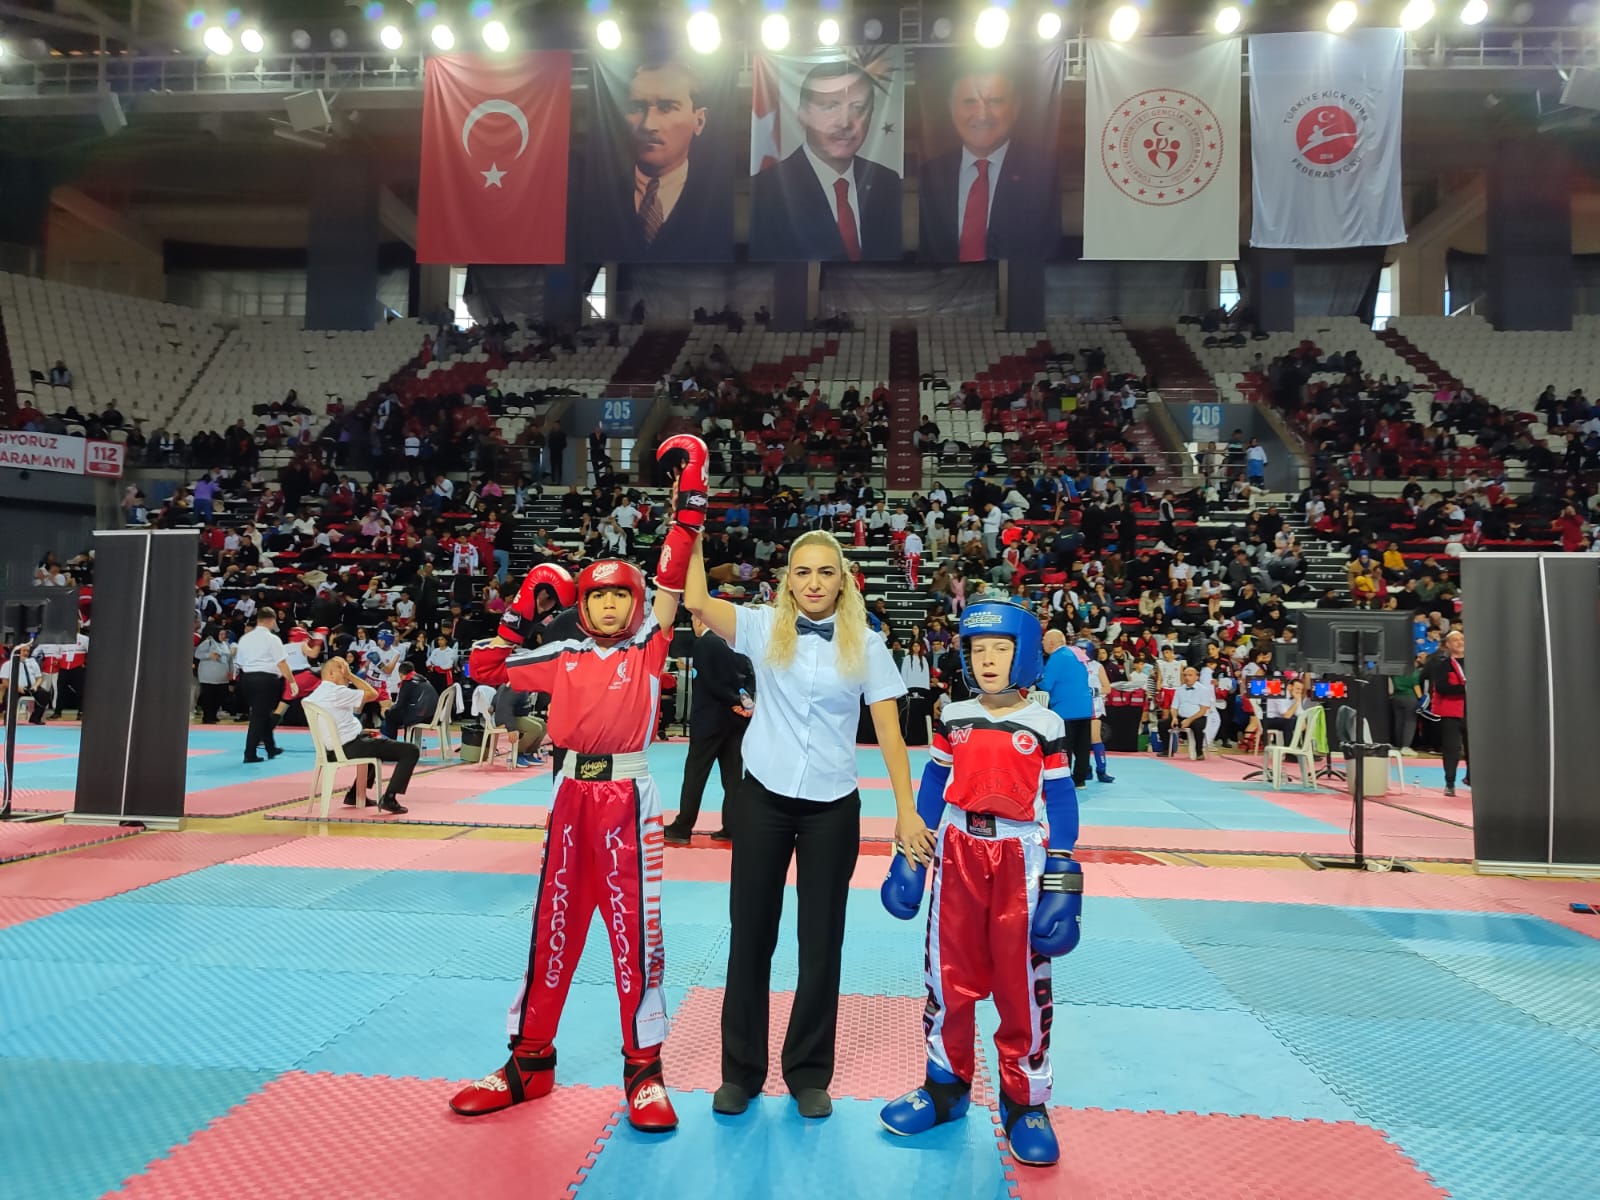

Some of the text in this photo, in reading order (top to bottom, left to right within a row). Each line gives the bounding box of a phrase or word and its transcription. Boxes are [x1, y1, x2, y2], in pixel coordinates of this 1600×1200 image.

[604, 400, 631, 420] 205
[1191, 405, 1221, 426] 206
[0, 450, 76, 470] ARAMAYIN
[93, 446, 118, 462] 112
